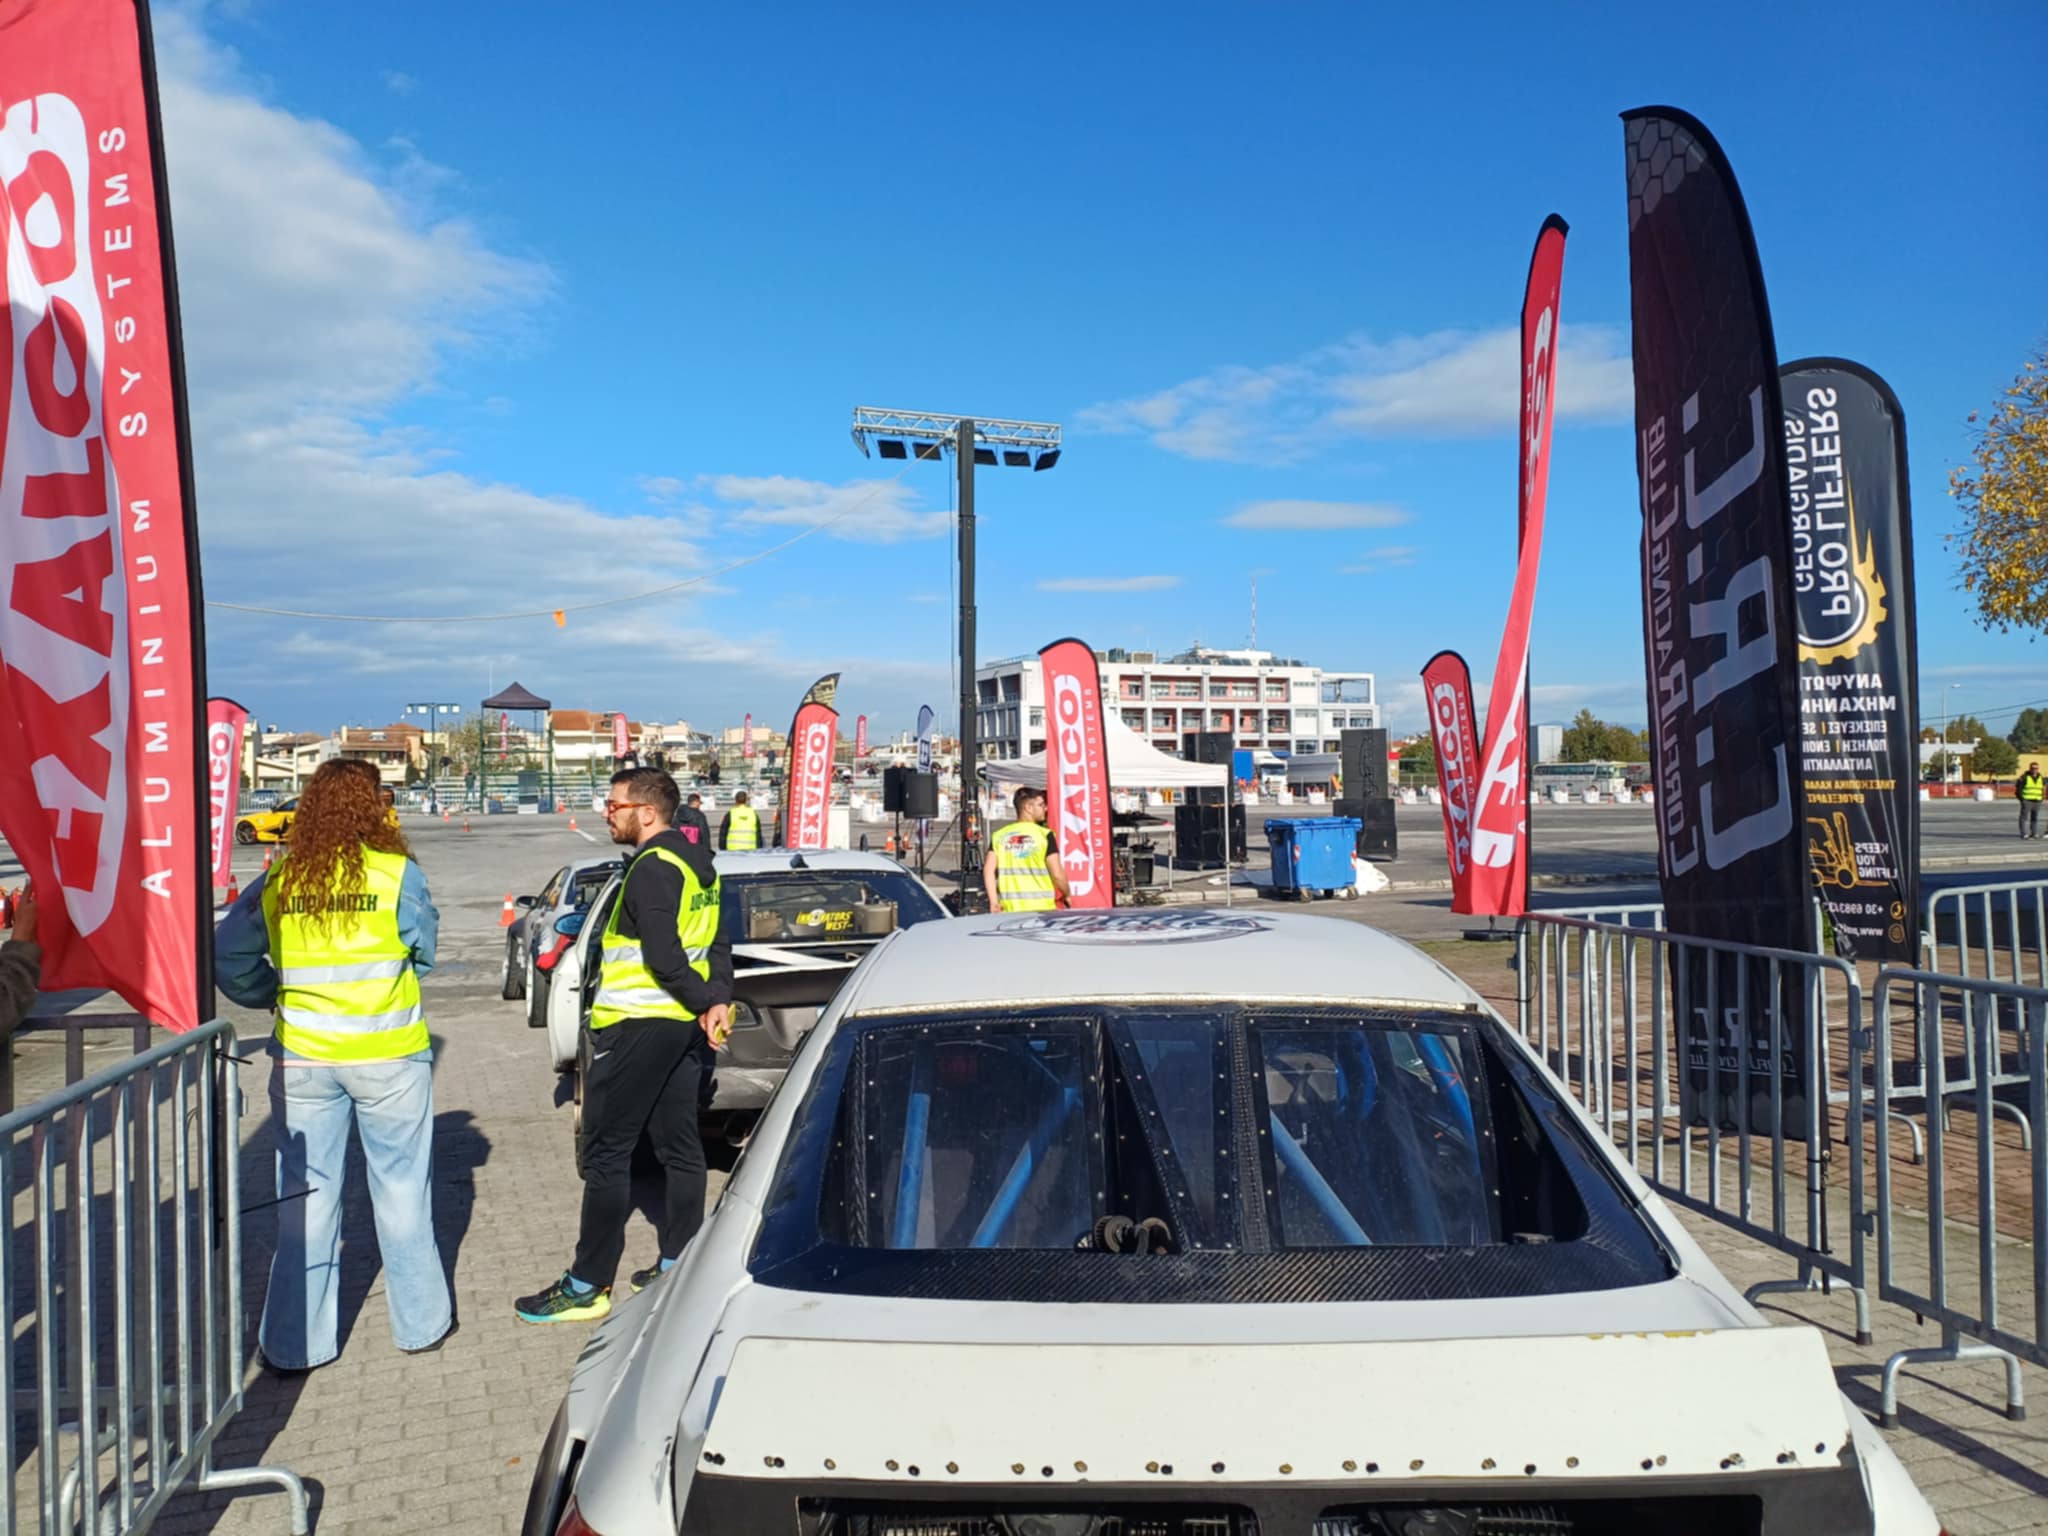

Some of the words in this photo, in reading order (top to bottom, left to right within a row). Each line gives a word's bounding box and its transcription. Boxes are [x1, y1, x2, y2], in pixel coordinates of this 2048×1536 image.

[98, 126, 148, 438] SYSTEMS
[134, 498, 172, 899] ALUMINIUM
[1058, 688, 1090, 883] EXALCO
[1084, 687, 1097, 768] SYSTEMS
